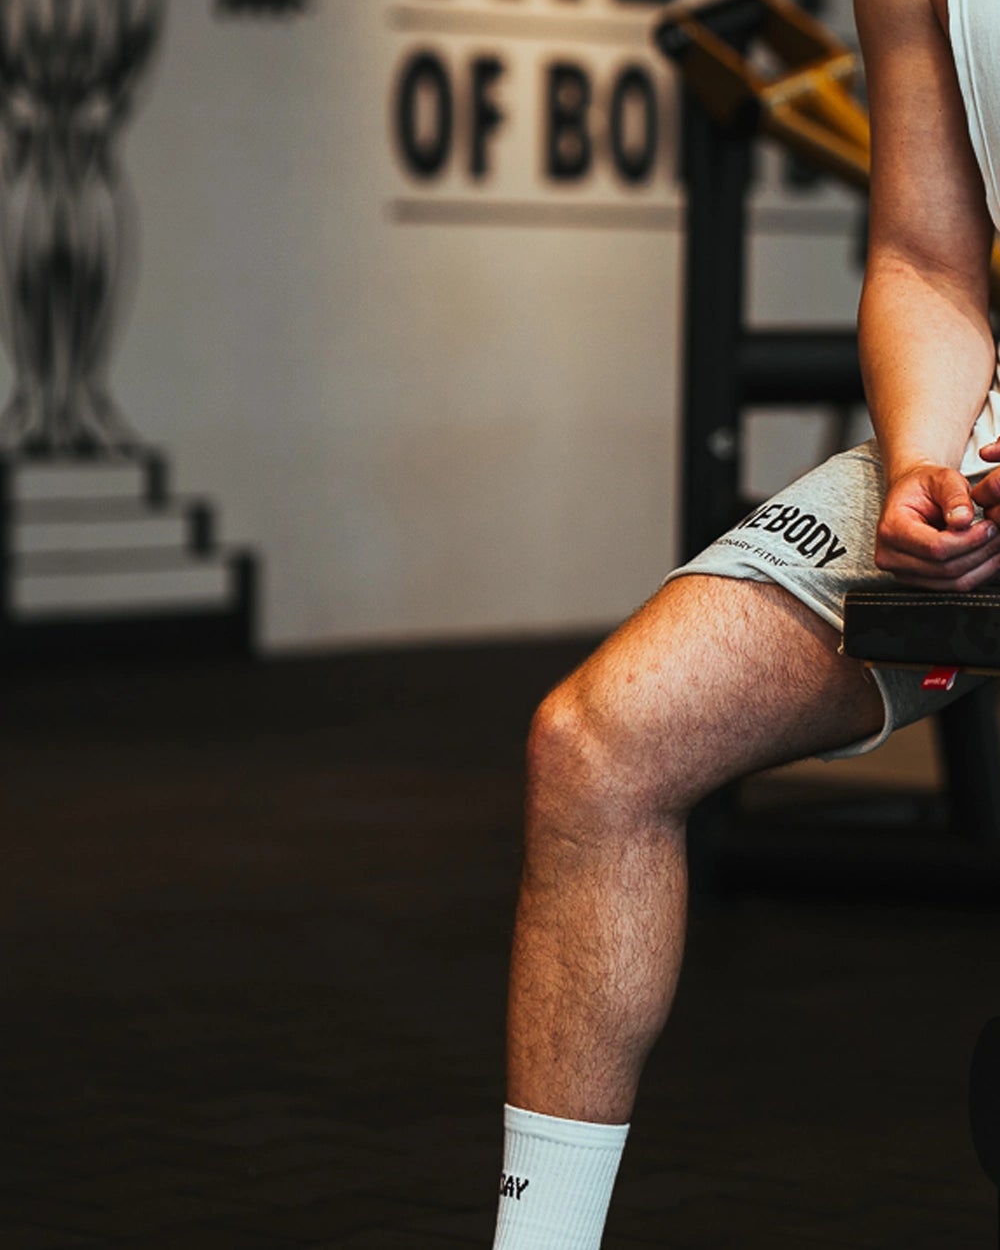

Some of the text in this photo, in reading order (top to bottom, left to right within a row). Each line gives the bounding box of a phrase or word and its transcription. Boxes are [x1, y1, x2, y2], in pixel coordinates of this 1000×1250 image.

[396, 48, 683, 185] OF BO
[738, 503, 848, 568] EBODY
